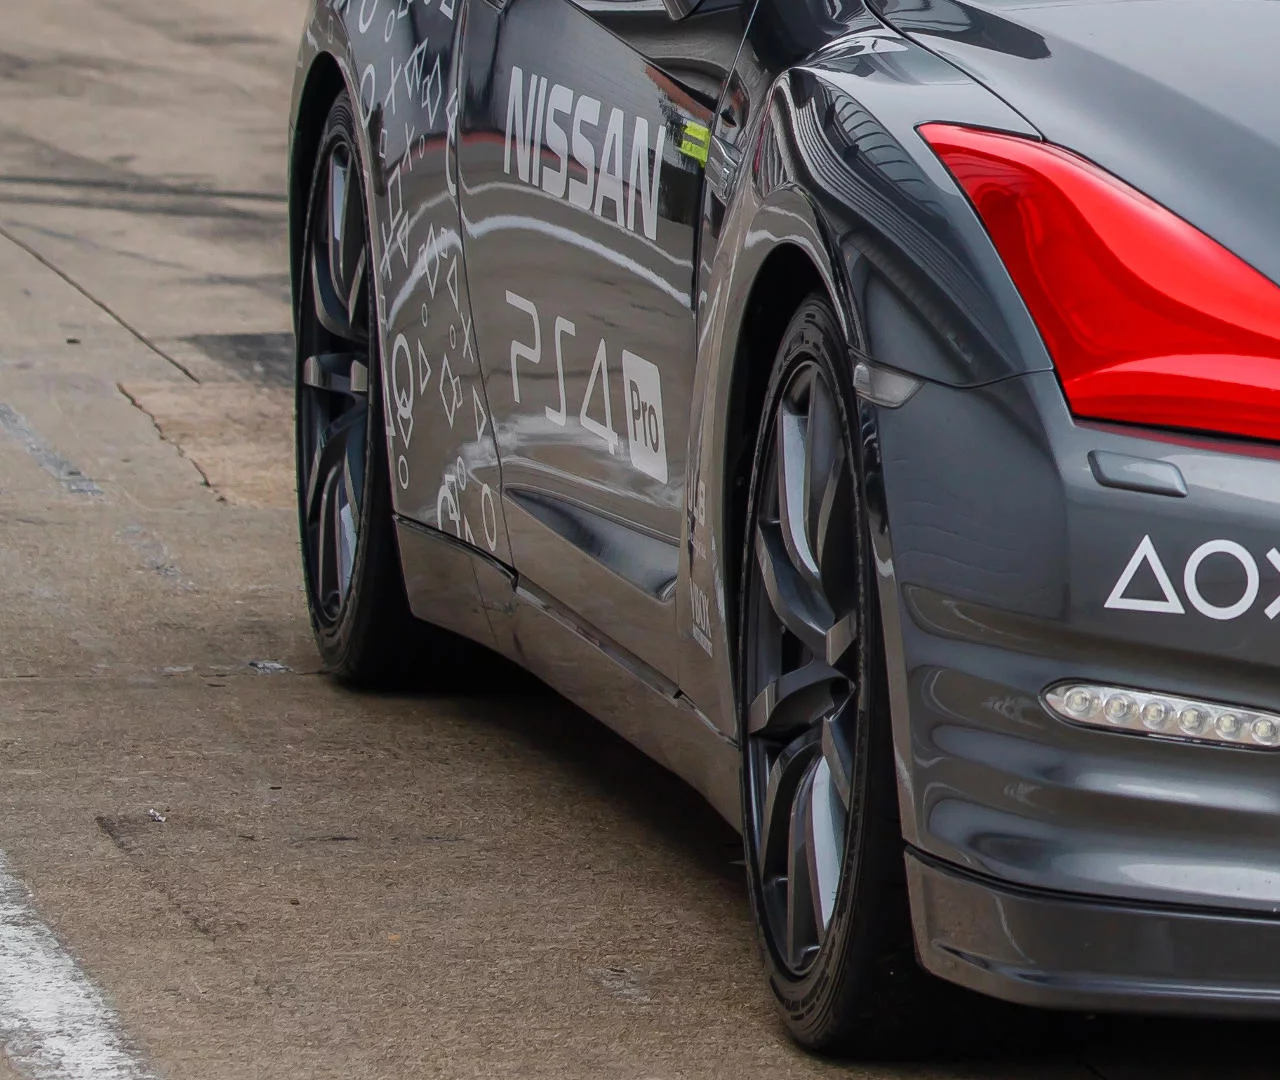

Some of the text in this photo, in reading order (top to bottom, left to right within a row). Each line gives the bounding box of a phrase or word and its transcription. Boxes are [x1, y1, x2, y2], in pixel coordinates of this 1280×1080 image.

[503, 65, 667, 241] NISSAN
[505, 289, 660, 456] PS4 Pro
